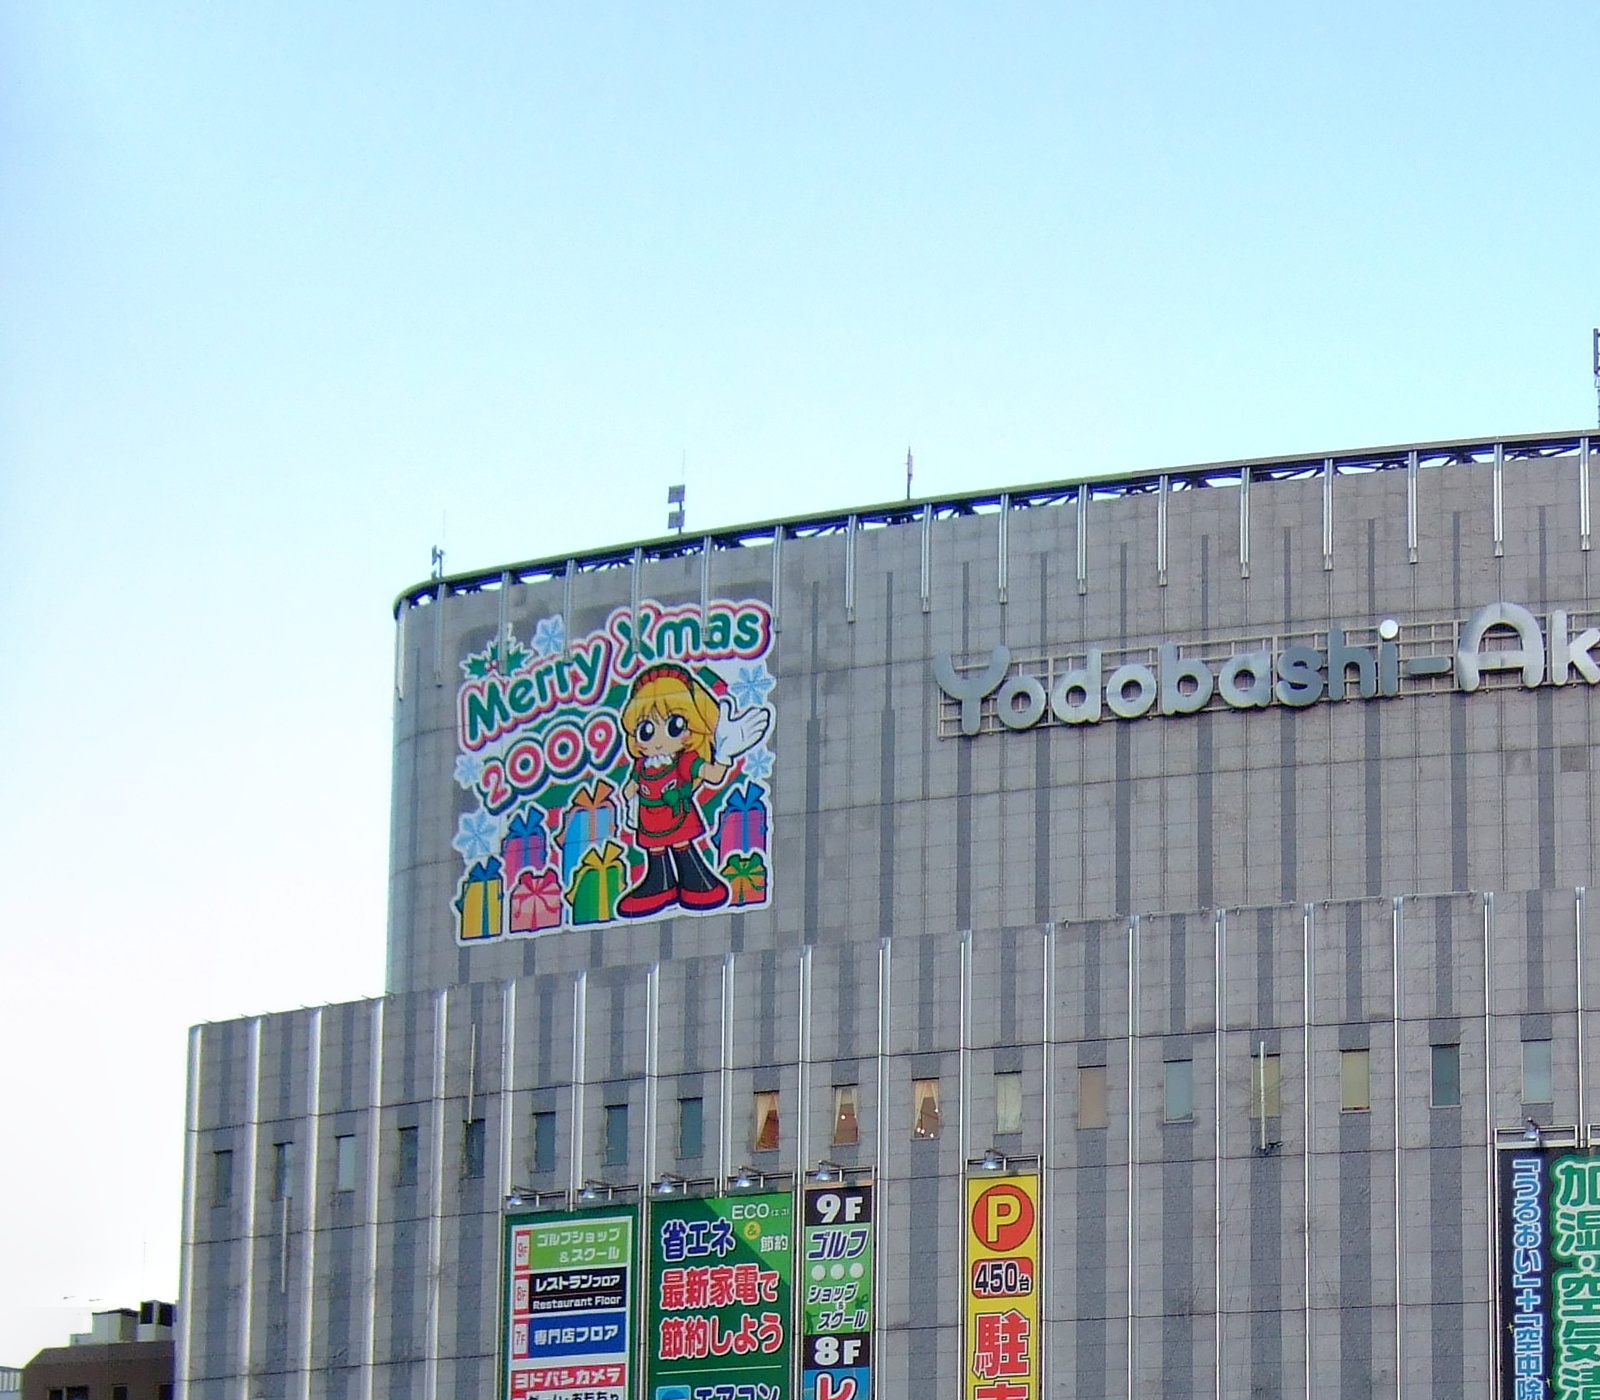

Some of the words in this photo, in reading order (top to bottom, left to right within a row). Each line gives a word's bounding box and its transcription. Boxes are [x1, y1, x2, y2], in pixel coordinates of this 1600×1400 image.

[462, 636, 612, 746] Merry
[617, 602, 770, 664] Xmas
[481, 716, 622, 808] 2009
[731, 1203, 771, 1220] ECO
[815, 1193, 863, 1223] 9F
[986, 1193, 1023, 1244] P
[537, 1228, 621, 1248] ゴルフショップ
[662, 1217, 736, 1263] 省エネ
[808, 1228, 869, 1262] ゴルフ
[535, 1274, 621, 1293] レストランフロア
[660, 1263, 780, 1310] 最新家電で
[808, 1283, 858, 1304] ショップ
[975, 1261, 1031, 1296] 450台
[532, 1296, 594, 1311] Restaurant
[594, 1295, 622, 1306] Floor
[533, 1325, 619, 1346] 専門店フロア
[659, 1312, 784, 1359] 節約しよう
[817, 1311, 868, 1330] スクール
[814, 1336, 862, 1366] 8F
[515, 1367, 621, 1390] ヨドバシカメラ
